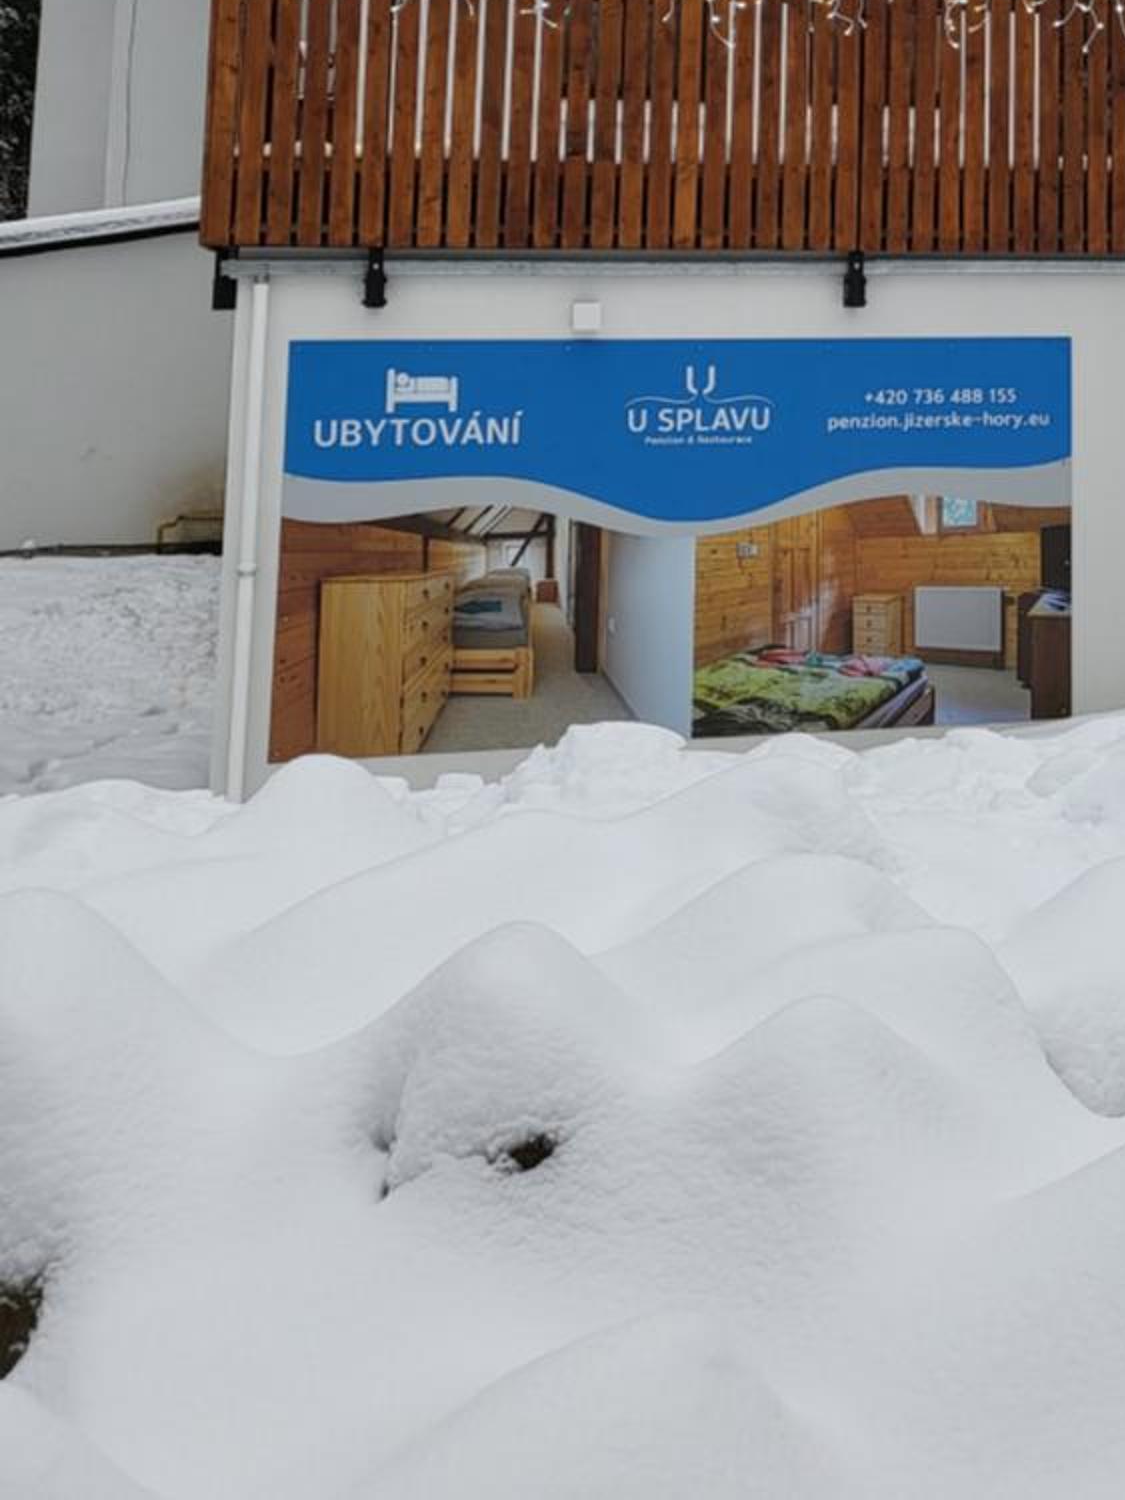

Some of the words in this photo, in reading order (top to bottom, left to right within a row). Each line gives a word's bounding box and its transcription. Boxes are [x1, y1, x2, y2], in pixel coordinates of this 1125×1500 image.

[863, 388, 908, 406] +420
[913, 388, 945, 405] 736
[950, 387, 984, 404] 488
[989, 387, 1018, 403] 155
[313, 410, 524, 448] UBYTOVÁNÍ
[627, 407, 648, 433] U
[657, 406, 771, 433] SPLAVU
[826, 411, 1051, 433] penzion.jizerske-hory.eu
